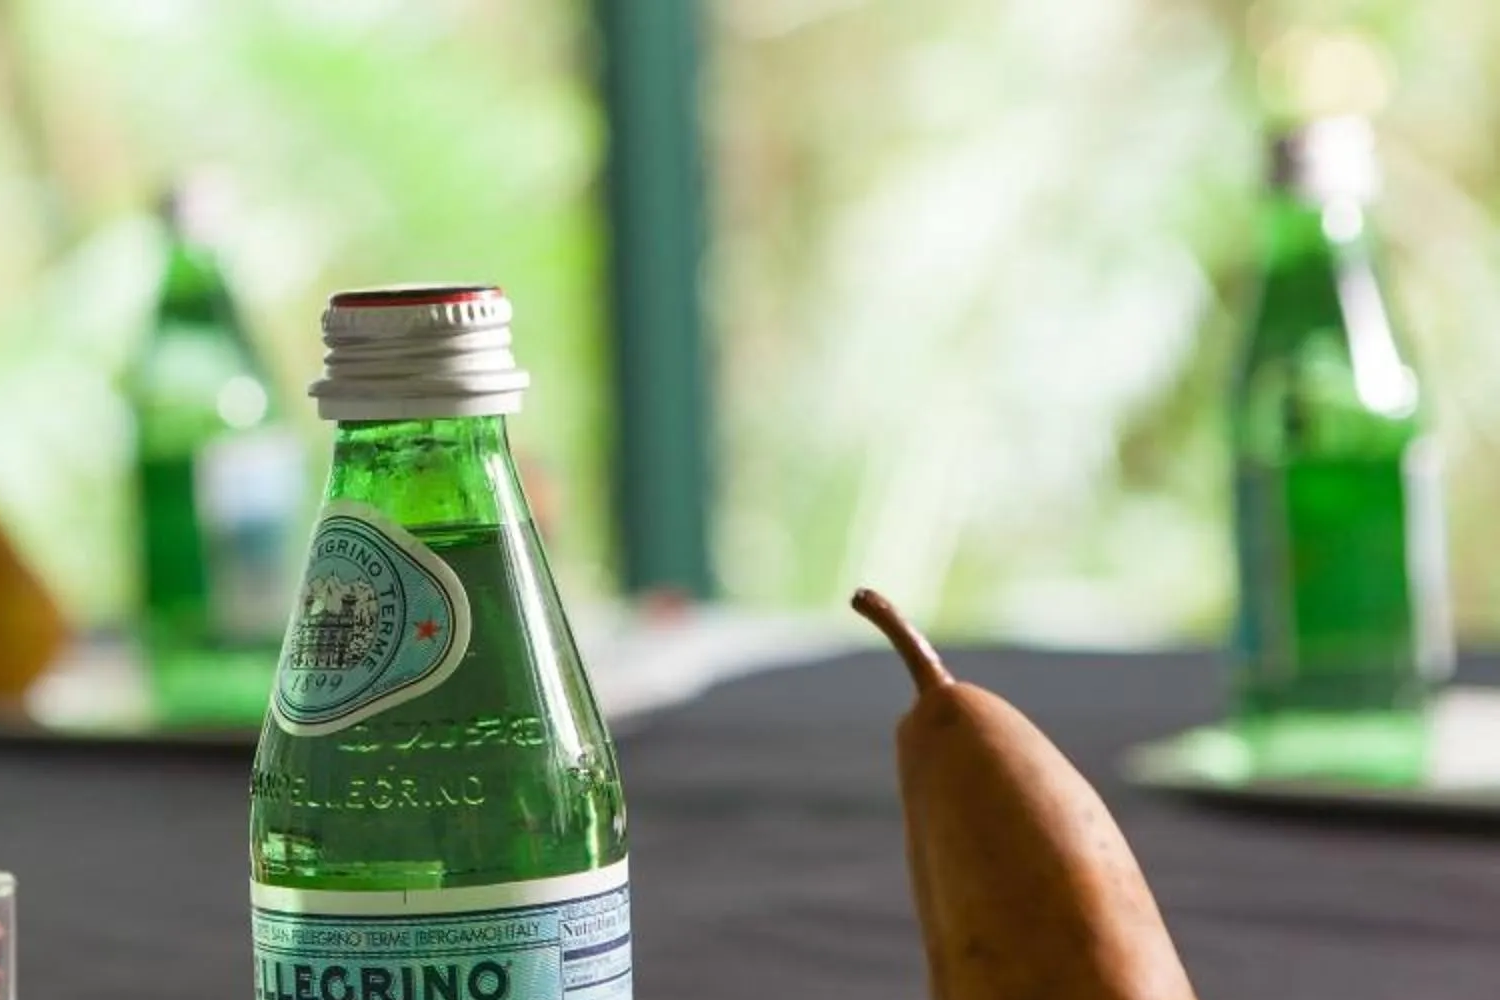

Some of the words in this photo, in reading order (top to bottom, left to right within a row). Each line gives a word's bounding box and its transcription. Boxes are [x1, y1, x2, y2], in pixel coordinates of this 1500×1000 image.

[361, 583, 397, 673] TERME
[291, 672, 344, 694] 1899
[366, 930, 410, 947] TERME
[505, 920, 541, 941] ITALY
